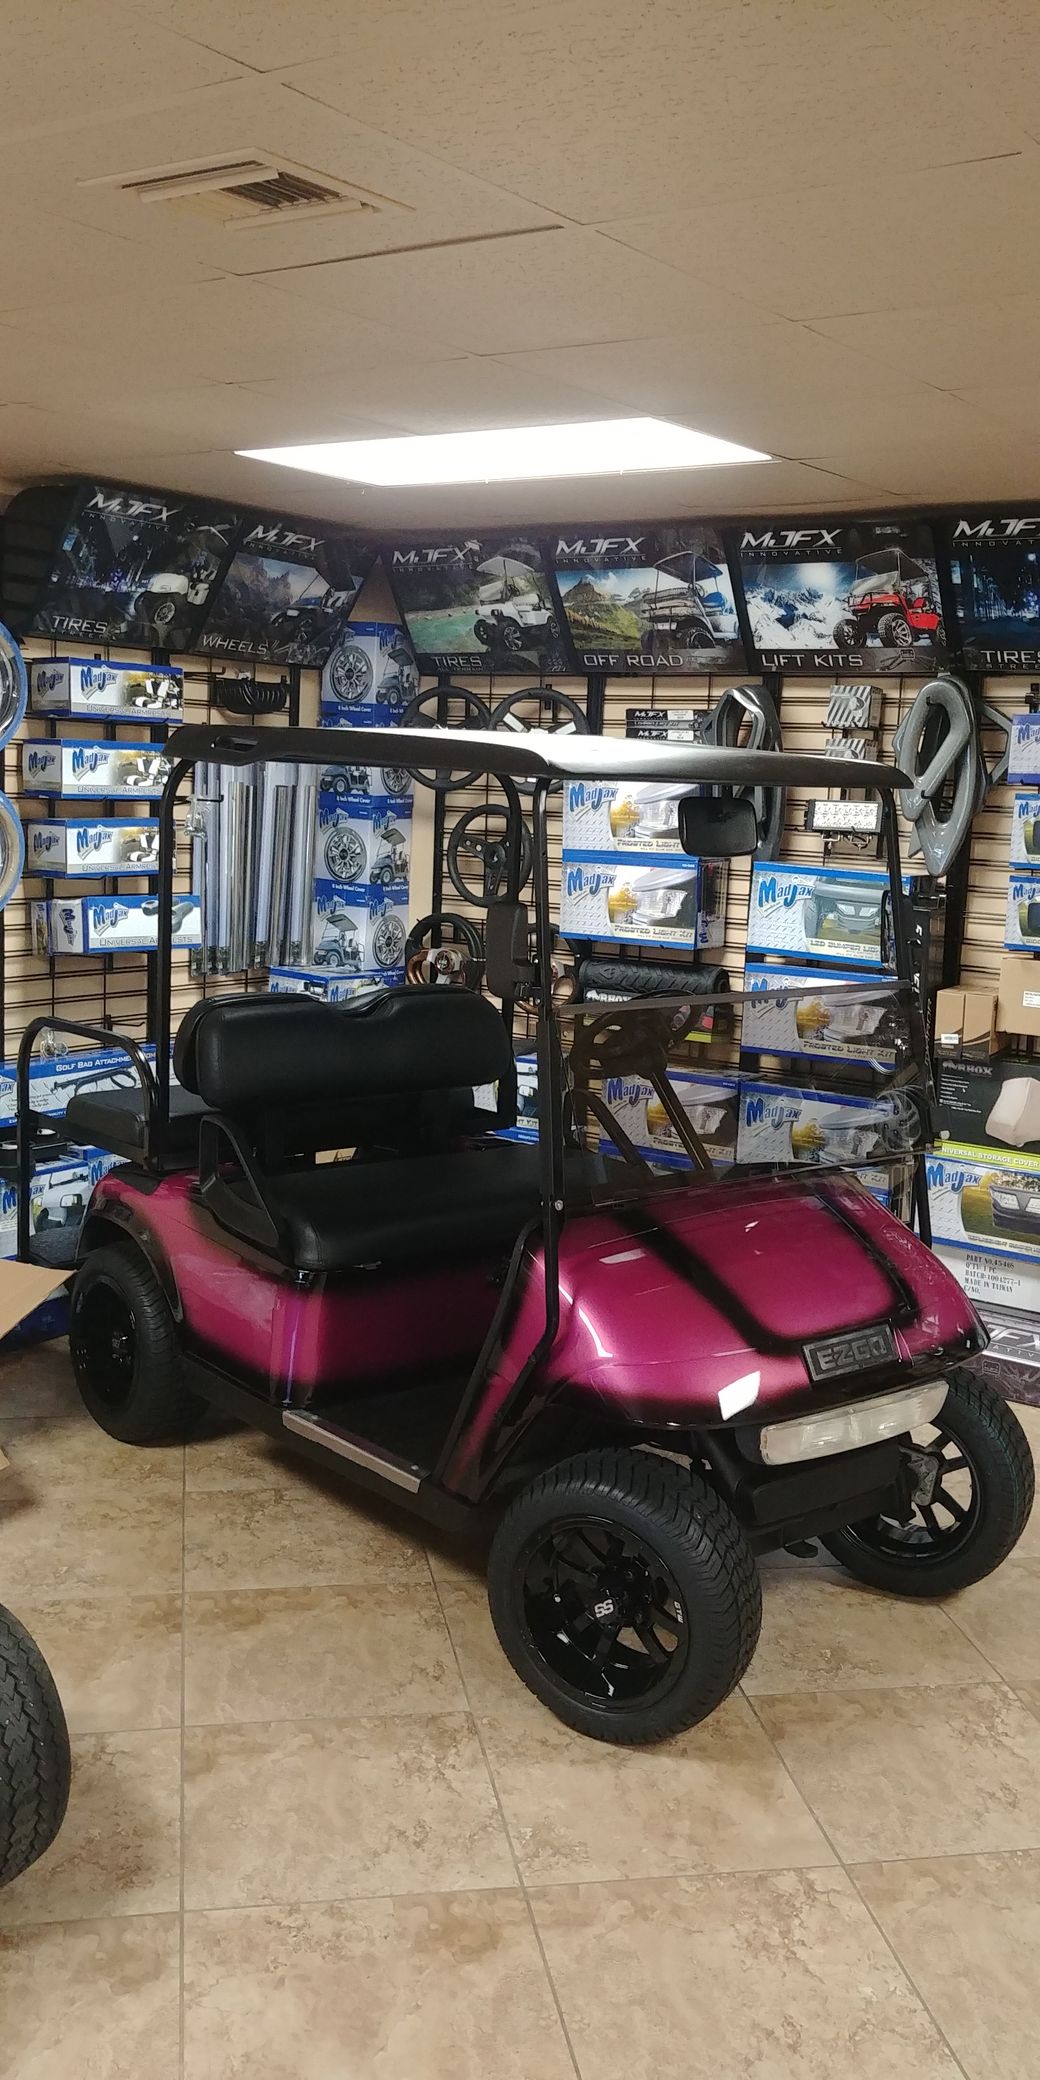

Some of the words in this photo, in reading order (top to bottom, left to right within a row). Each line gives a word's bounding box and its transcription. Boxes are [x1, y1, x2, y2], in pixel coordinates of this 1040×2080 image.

[556, 555, 646, 564] INNOVATIVE
[740, 549, 842, 557] INNOVATIVE
[52, 615, 108, 634] TIRES
[203, 635, 267, 654] WHEELS
[431, 655, 482, 668] TIRES
[583, 654, 619, 666] OFF
[626, 654, 683, 666] ROAD
[761, 654, 804, 668] LIFT
[815, 654, 863, 667] KITS
[570, 784, 617, 811] MadJax
[568, 867, 616, 896] MadJax
[758, 877, 813, 907] MadJax
[99, 937, 147, 946] UNIVERSAL
[804, 1041, 843, 1051] FROSTED
[847, 1045, 875, 1055] LIGHT
[56, 1063, 76, 1072] GOLF
[607, 1077, 654, 1104] MadJax
[747, 1099, 802, 1128] MadJax
[979, 1153, 1011, 1163] STORAGE
[1014, 1158, 1038, 1167] COVER
[927, 1163, 980, 1192] MadJax
[966, 1254, 982, 1262] PART
[965, 1277, 981, 1286] MADE
[992, 1283, 1013, 1293] TAIWAN
[594, 1599, 614, 1618] SS
[673, 1601, 684, 1624] GTW
